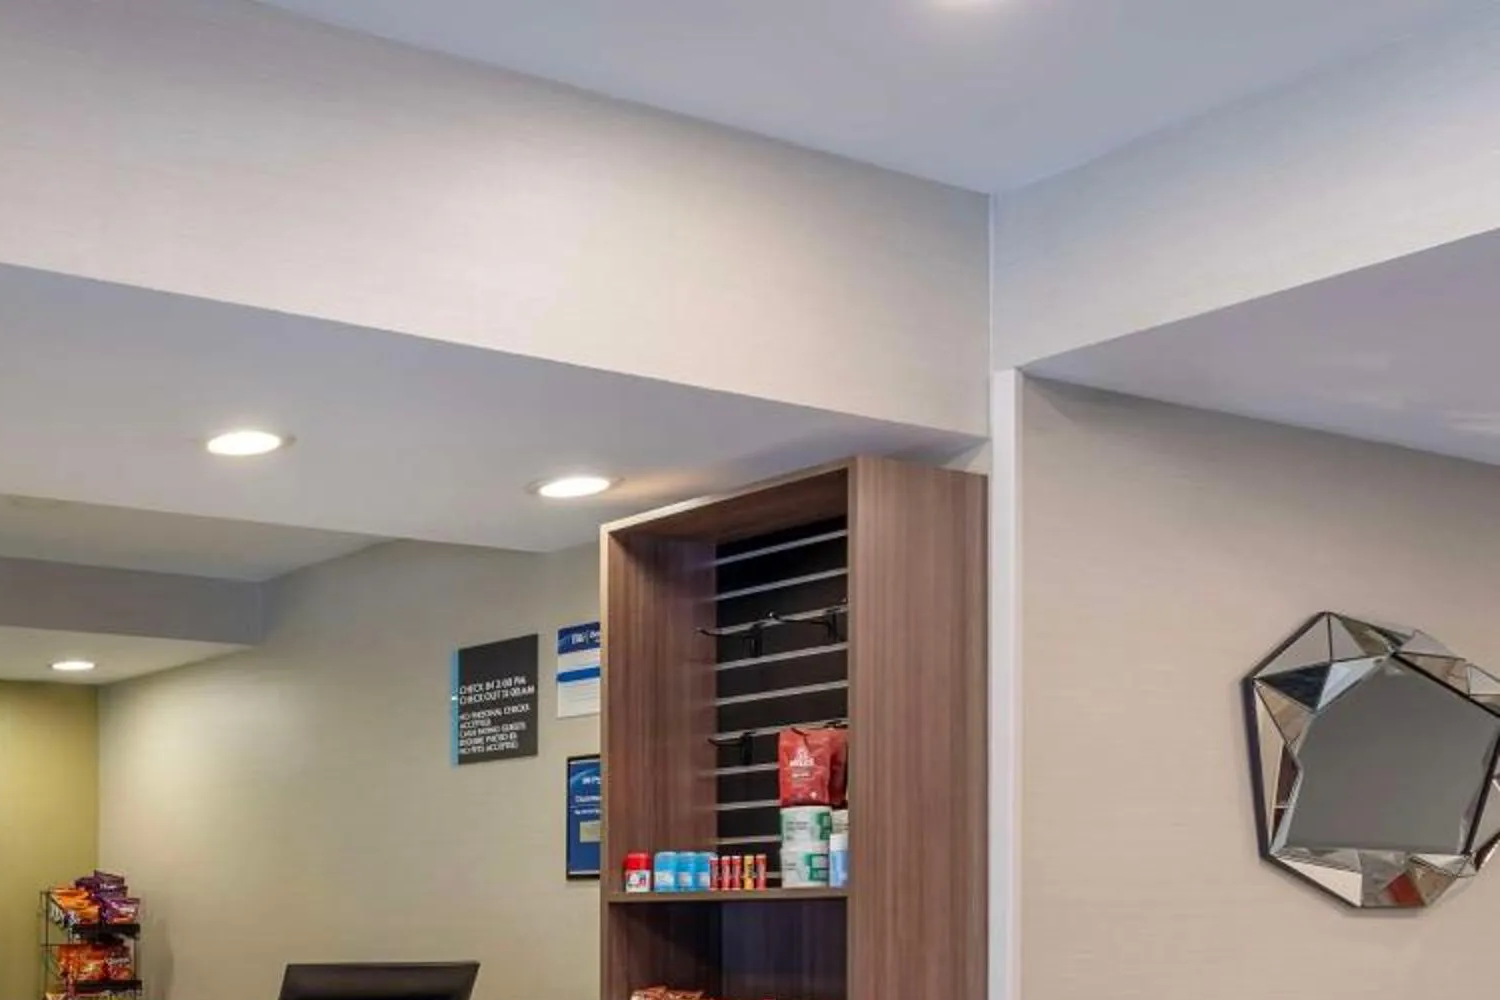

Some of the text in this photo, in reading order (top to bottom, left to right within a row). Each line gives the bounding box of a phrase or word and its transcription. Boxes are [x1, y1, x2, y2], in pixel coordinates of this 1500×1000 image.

[459, 683, 484, 695] CHECK
[459, 693, 483, 705] CHECK
[483, 691, 501, 701] OUT
